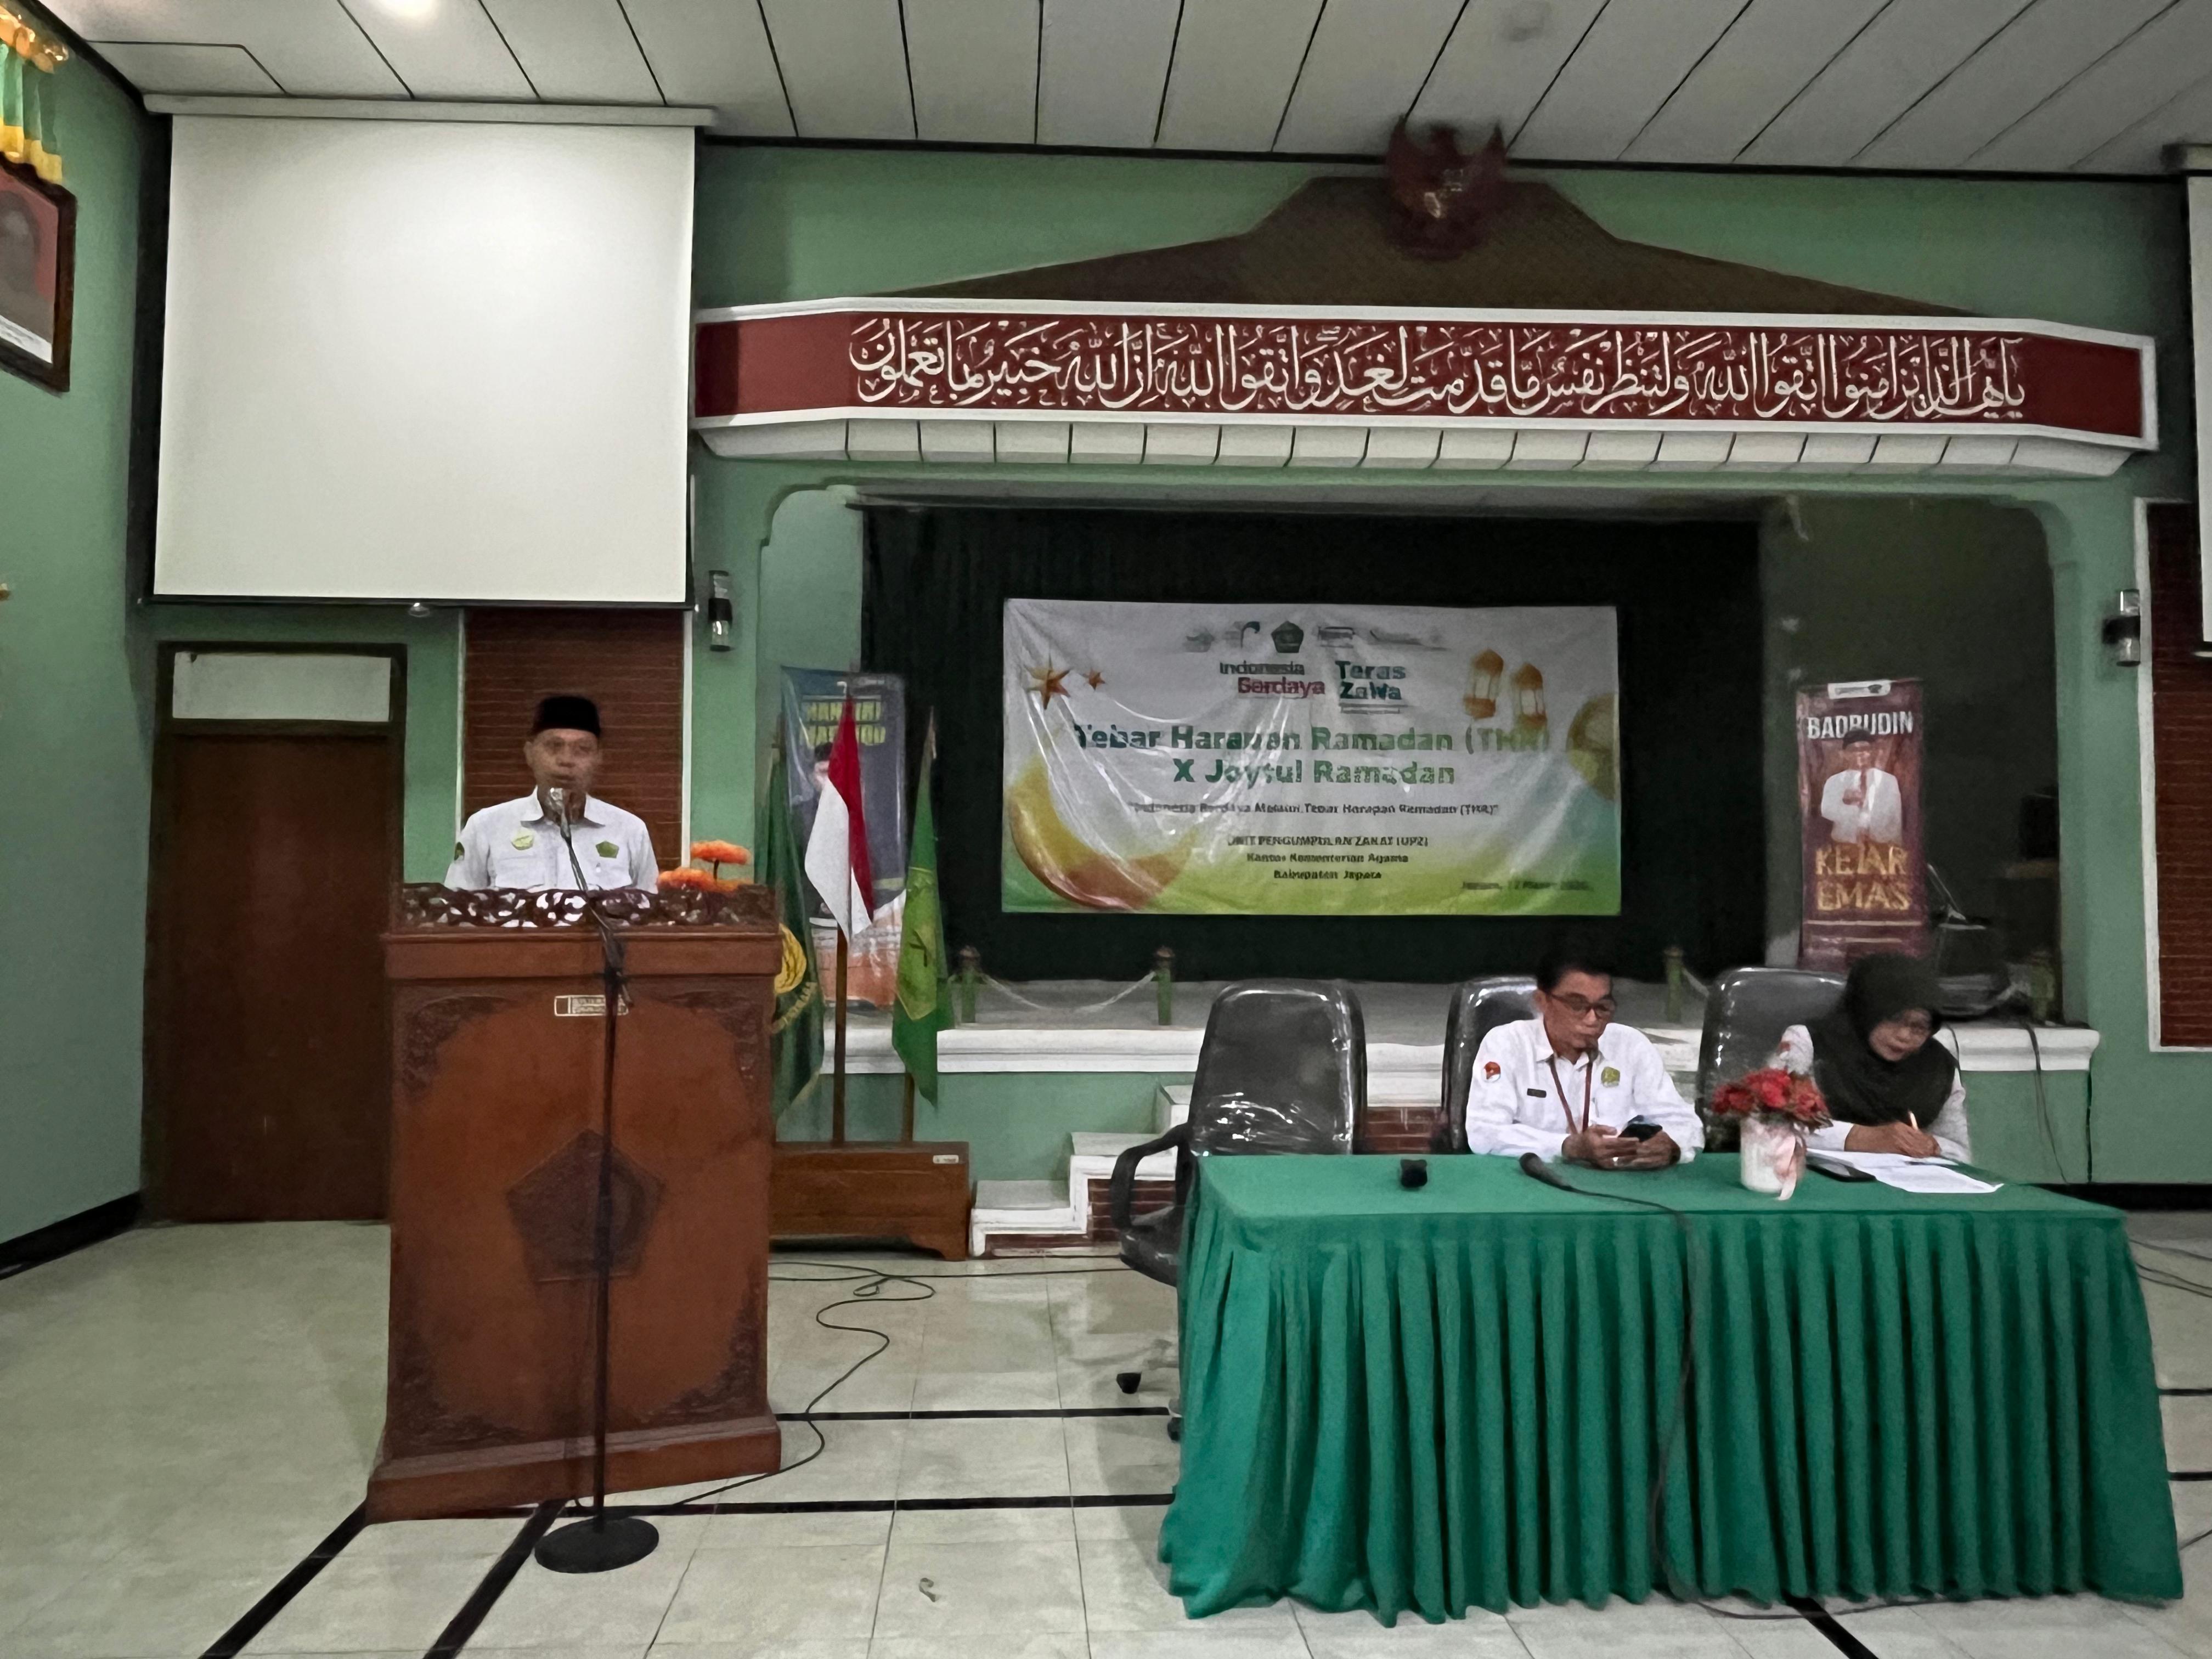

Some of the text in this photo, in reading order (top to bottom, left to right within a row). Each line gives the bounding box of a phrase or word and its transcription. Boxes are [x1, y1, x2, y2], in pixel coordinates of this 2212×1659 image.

[1335, 661, 1407, 680] Teras
[1312, 726, 1453, 751] Ramadan
[1172, 759, 1195, 783] X
[1314, 760, 1455, 784] Ramadan
[1817, 881, 1912, 911] EMAS
